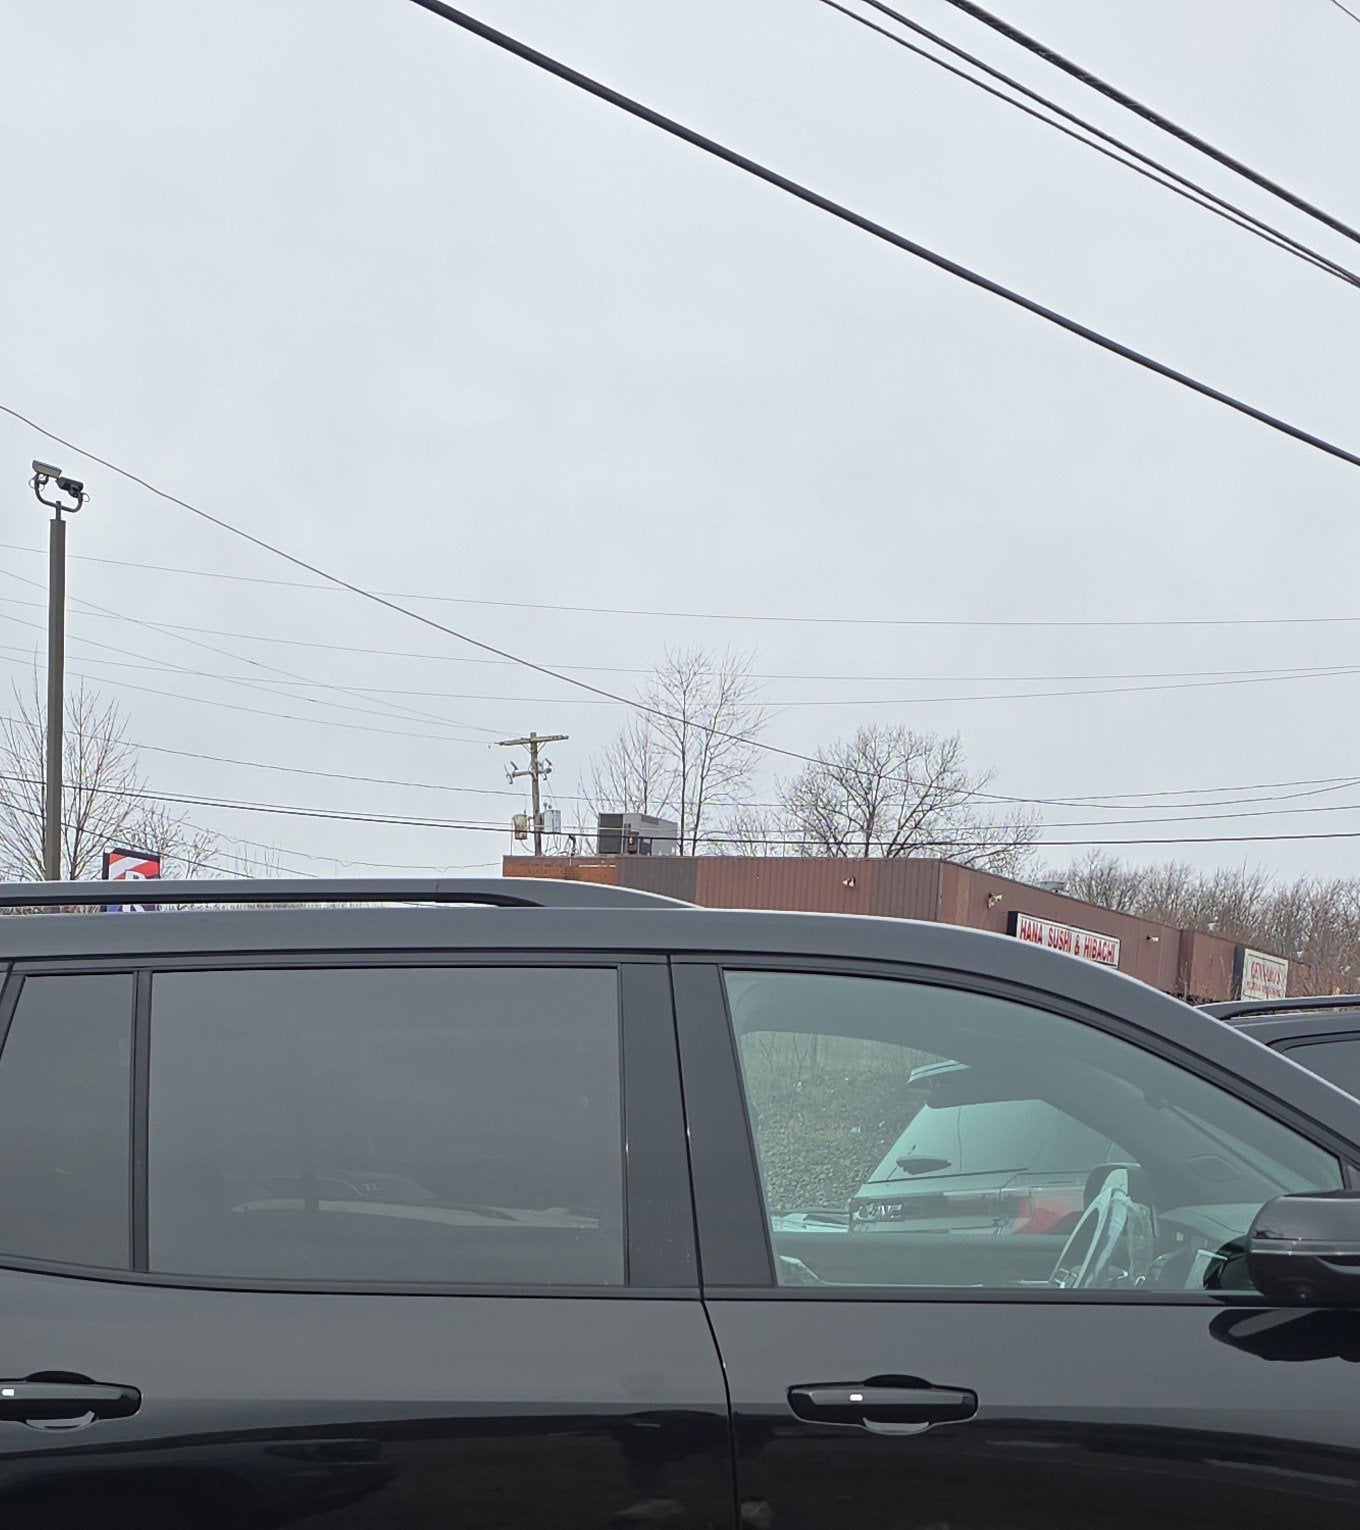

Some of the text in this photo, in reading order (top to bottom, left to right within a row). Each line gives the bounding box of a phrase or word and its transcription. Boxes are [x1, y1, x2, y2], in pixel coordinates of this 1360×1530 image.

[1020, 919, 1116, 963] HANA SUSHI & HIBACHI
